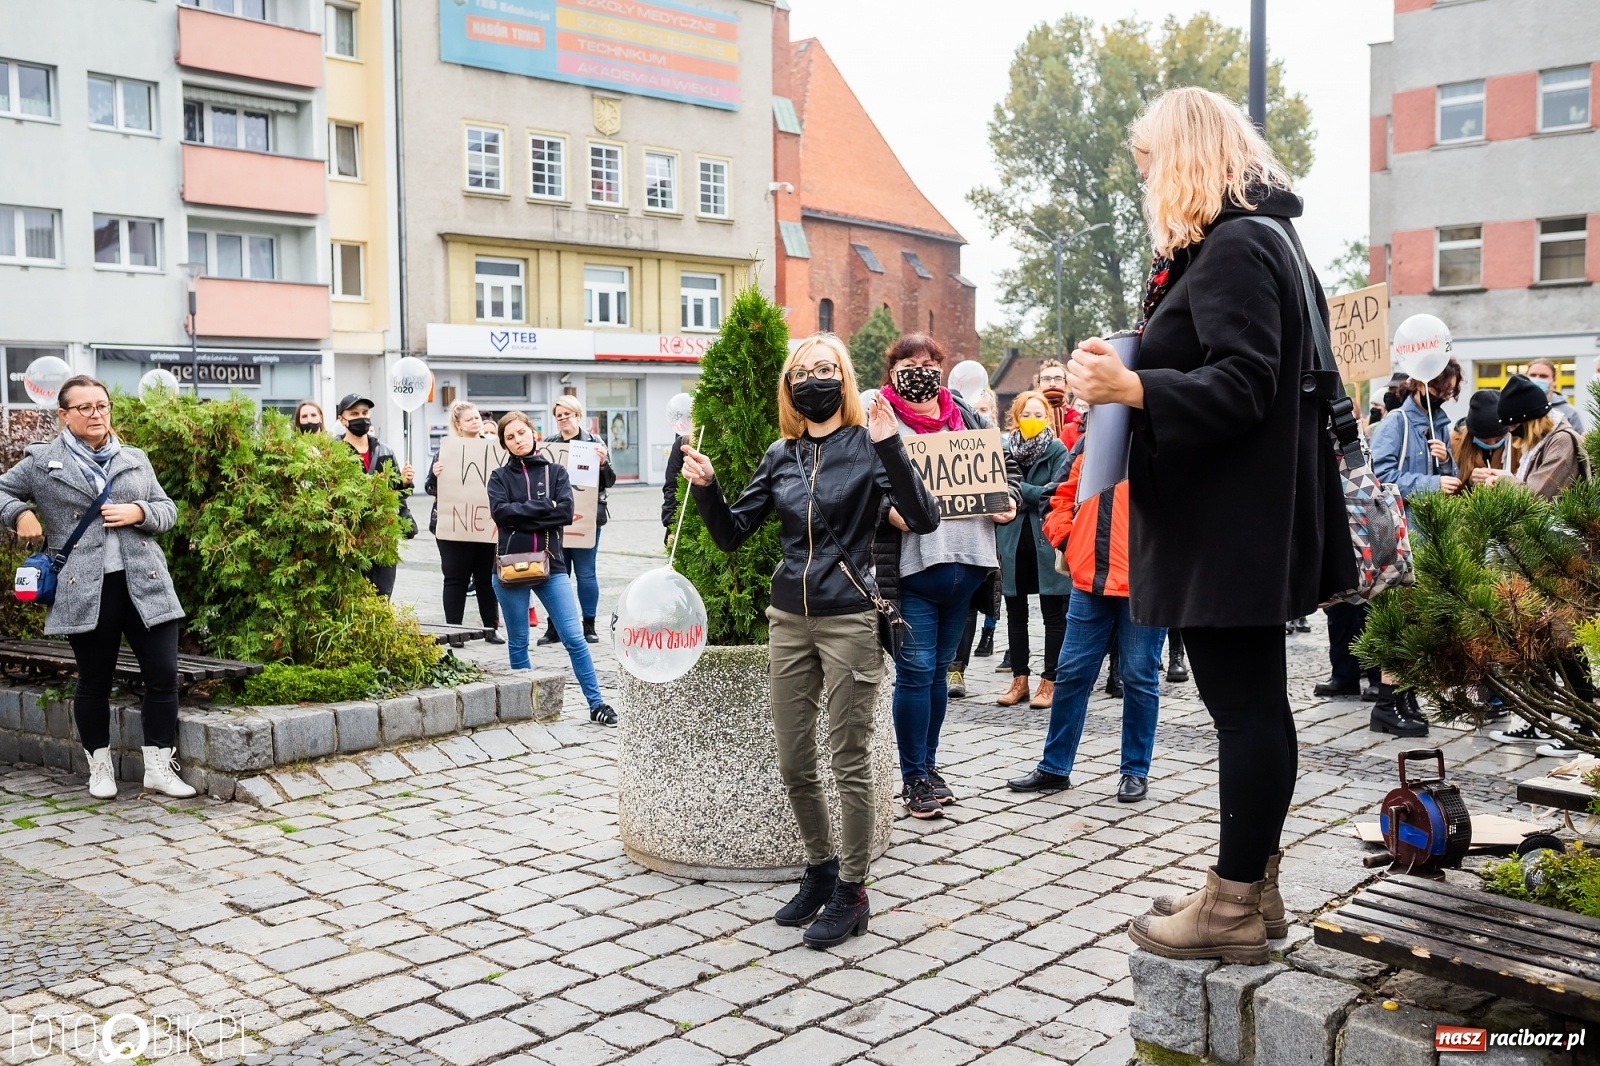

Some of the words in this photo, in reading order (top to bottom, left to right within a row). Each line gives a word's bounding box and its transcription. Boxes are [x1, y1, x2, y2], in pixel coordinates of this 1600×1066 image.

[472, 21, 509, 39] NABÓR
[511, 28, 541, 43] TRWA
[637, 7, 717, 34] MEDYCZNE
[576, 16, 637, 36] SZKOŁY
[639, 29, 725, 57] POLICEALNE
[577, 39, 667, 65] TECHNIKUM
[577, 62, 658, 87] AKADEMIA
[672, 79, 720, 97] WIEKU
[1333, 296, 1379, 330] ZĄD
[512, 331, 537, 343] TEB
[660, 335, 712, 355] ROSS
[1339, 329, 1356, 345] DO
[1333, 338, 1381, 366] BORCJI
[170, 363, 255, 384] geatopiu
[393, 385, 414, 394] 2020
[908, 441, 926, 455] TO
[949, 437, 986, 452] MOJA
[452, 503, 488, 533] NIE
